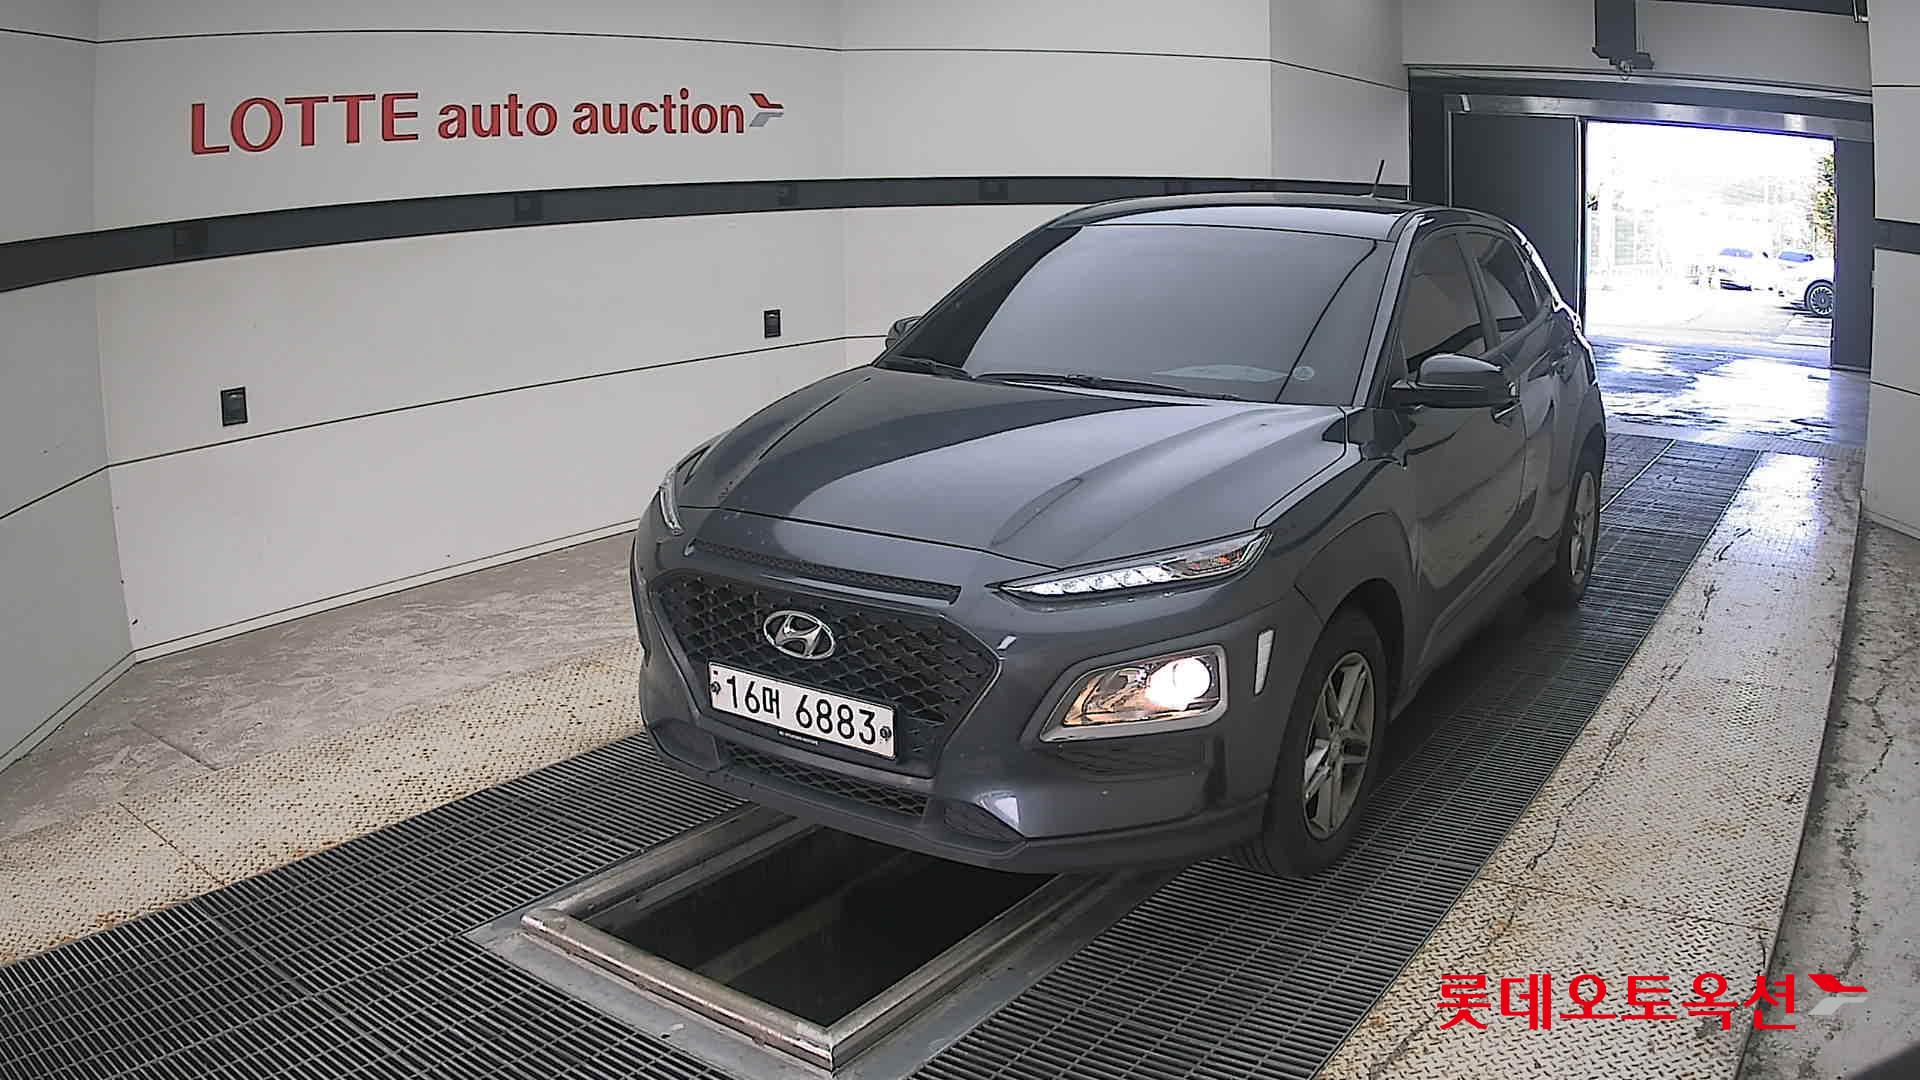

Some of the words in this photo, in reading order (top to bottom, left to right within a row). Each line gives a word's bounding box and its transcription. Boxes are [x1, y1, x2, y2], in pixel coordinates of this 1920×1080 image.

[190, 92, 420, 155] LOTTE
[437, 94, 558, 138] auto
[572, 88, 745, 134] auction
[726, 675, 780, 719] 16머
[795, 694, 876, 745] 6883
